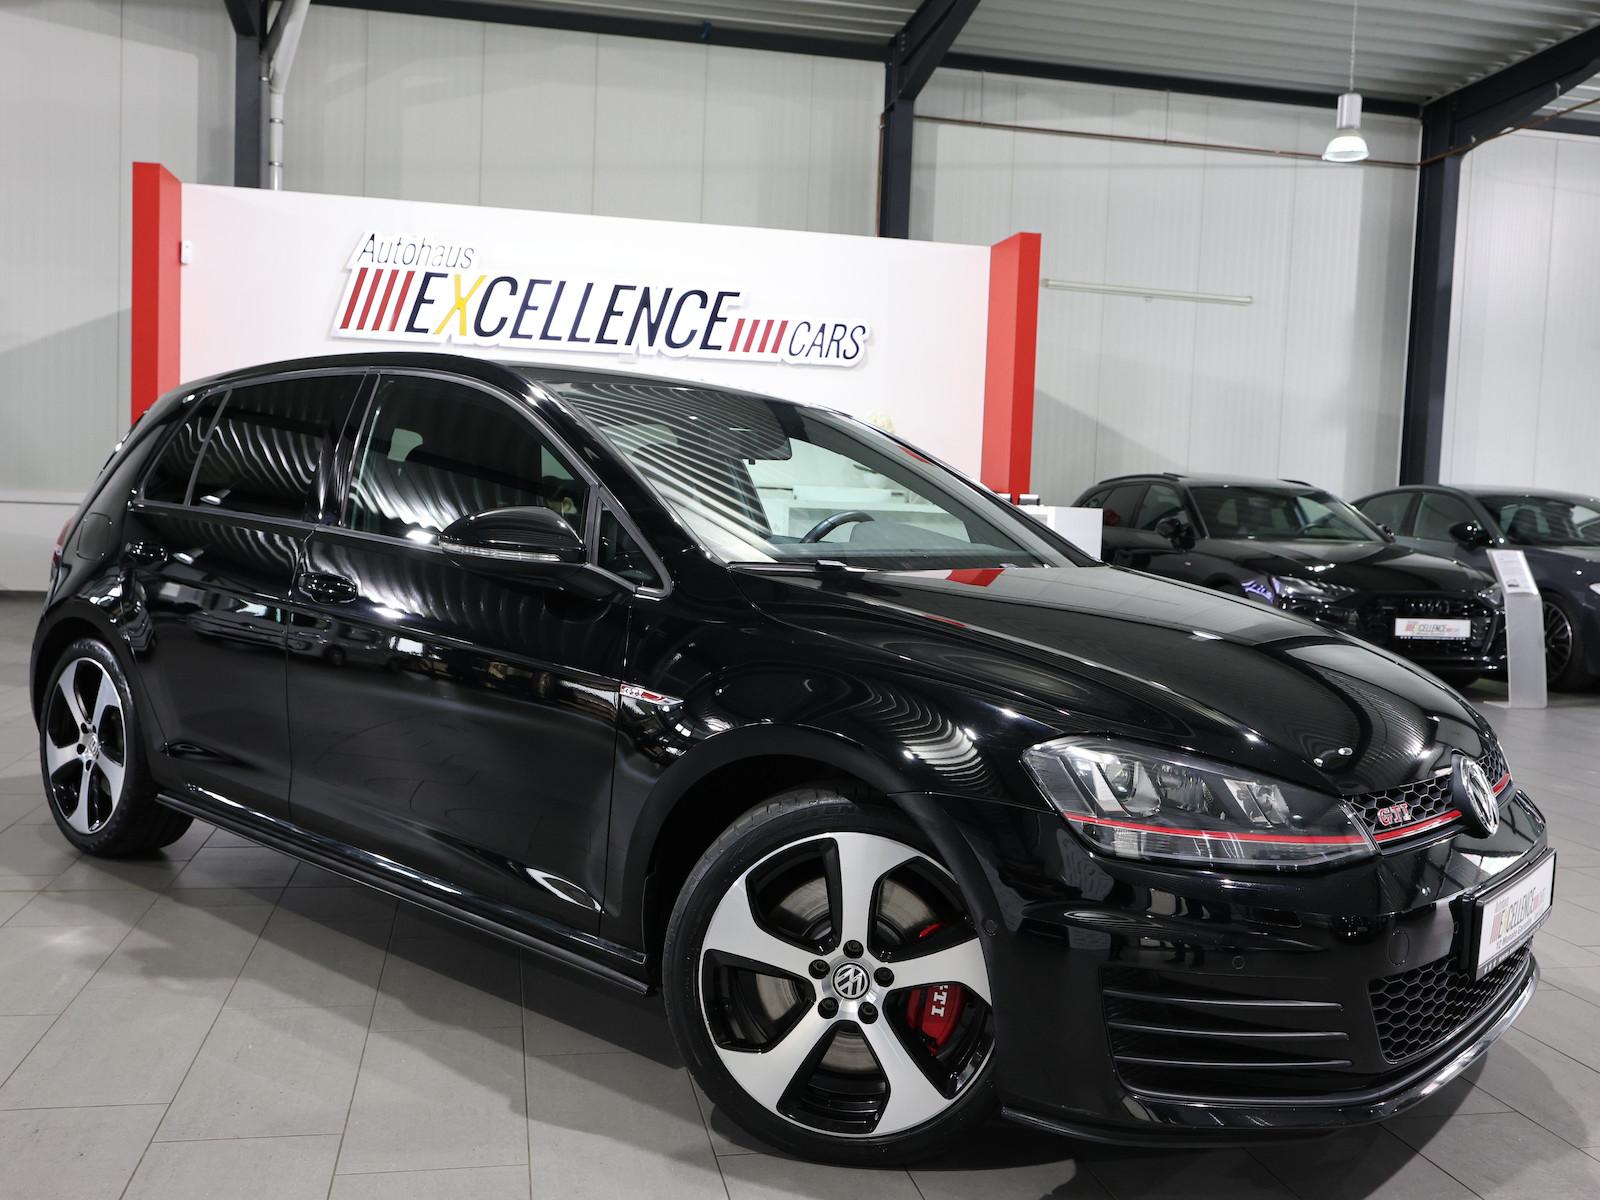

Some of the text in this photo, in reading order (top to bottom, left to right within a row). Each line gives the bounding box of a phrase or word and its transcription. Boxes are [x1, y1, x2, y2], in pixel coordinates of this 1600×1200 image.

[357, 233, 474, 270] Autohaus
[404, 271, 866, 360] EXCELLENCE CARS
[1377, 803, 1411, 826] GTI
[931, 985, 949, 1017] TI
